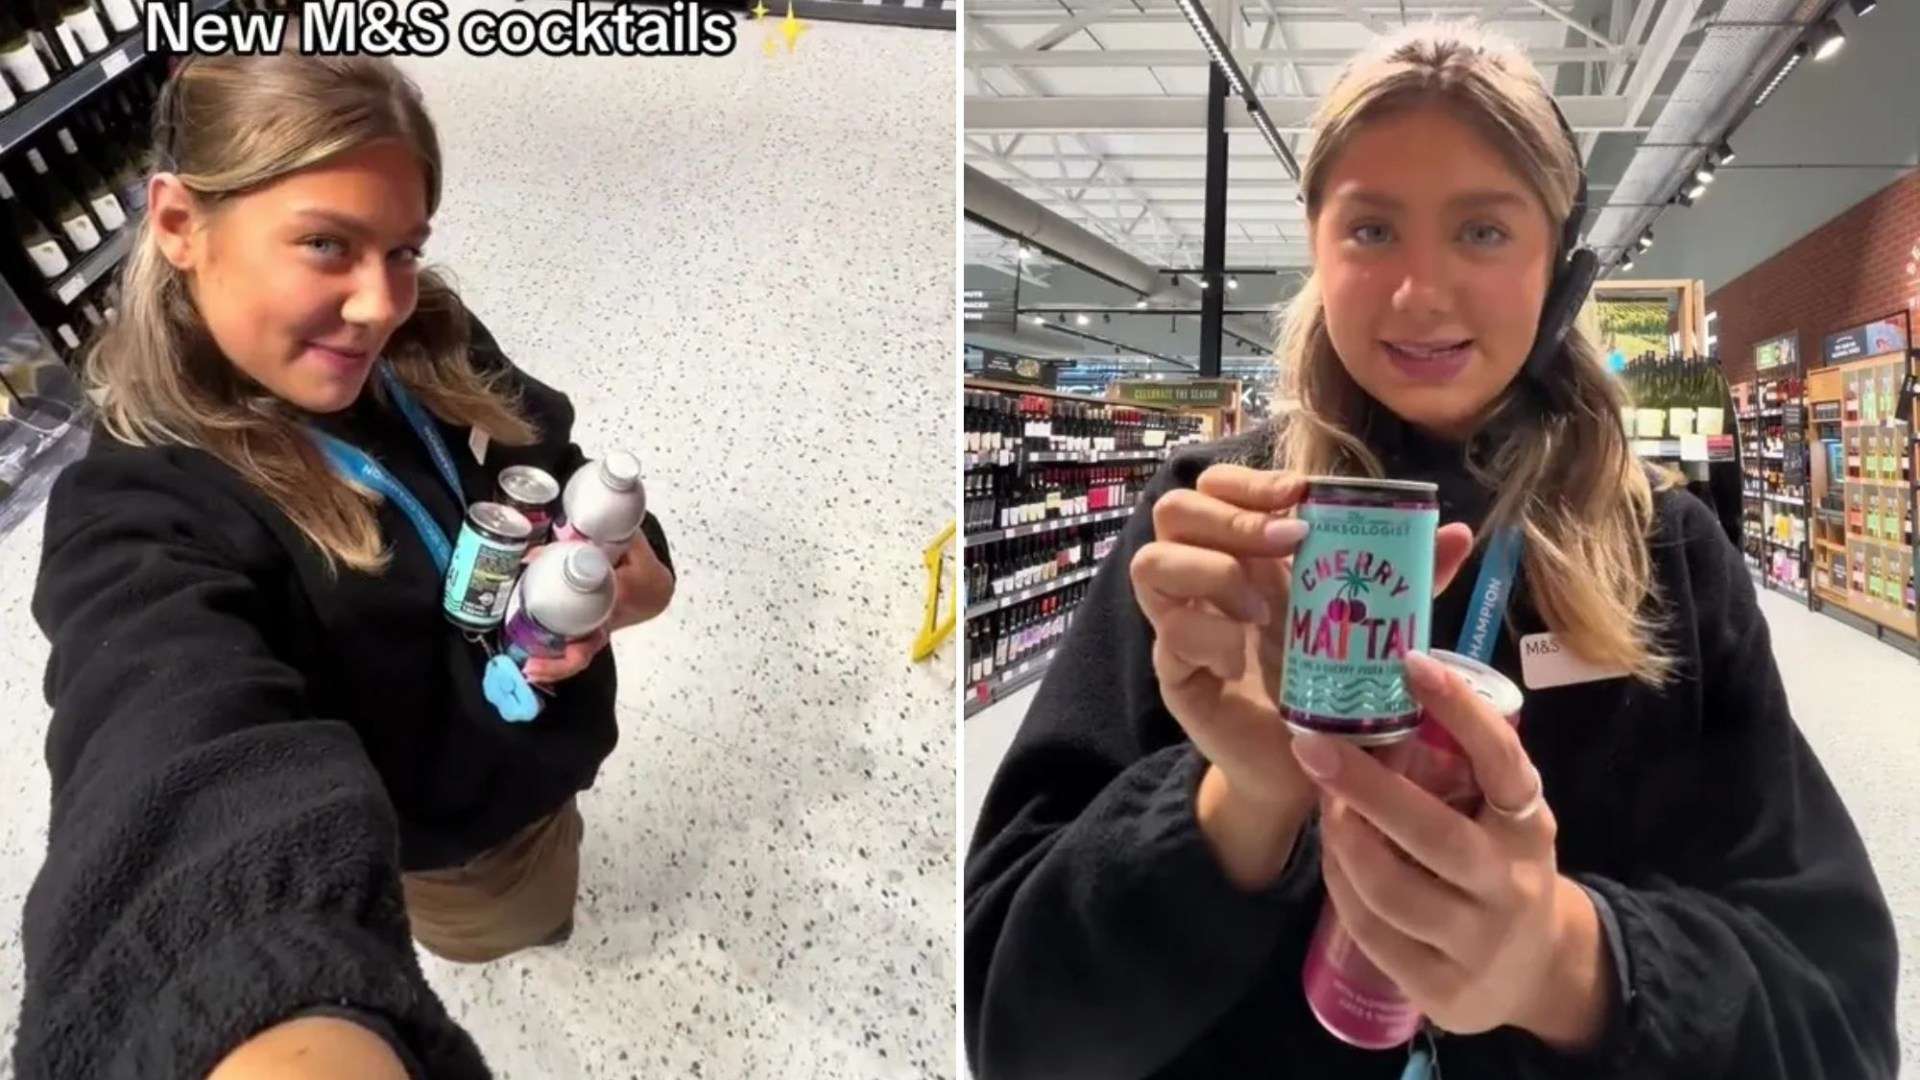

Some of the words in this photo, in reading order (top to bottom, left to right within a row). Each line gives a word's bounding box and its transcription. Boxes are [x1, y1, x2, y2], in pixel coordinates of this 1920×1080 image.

[1301, 551, 1409, 597] CHERRY
[1290, 605, 1350, 661] MAI
[1360, 612, 1417, 660] TAI
[1467, 576, 1502, 658] HAMPION
[1525, 640, 1560, 656] M&S
